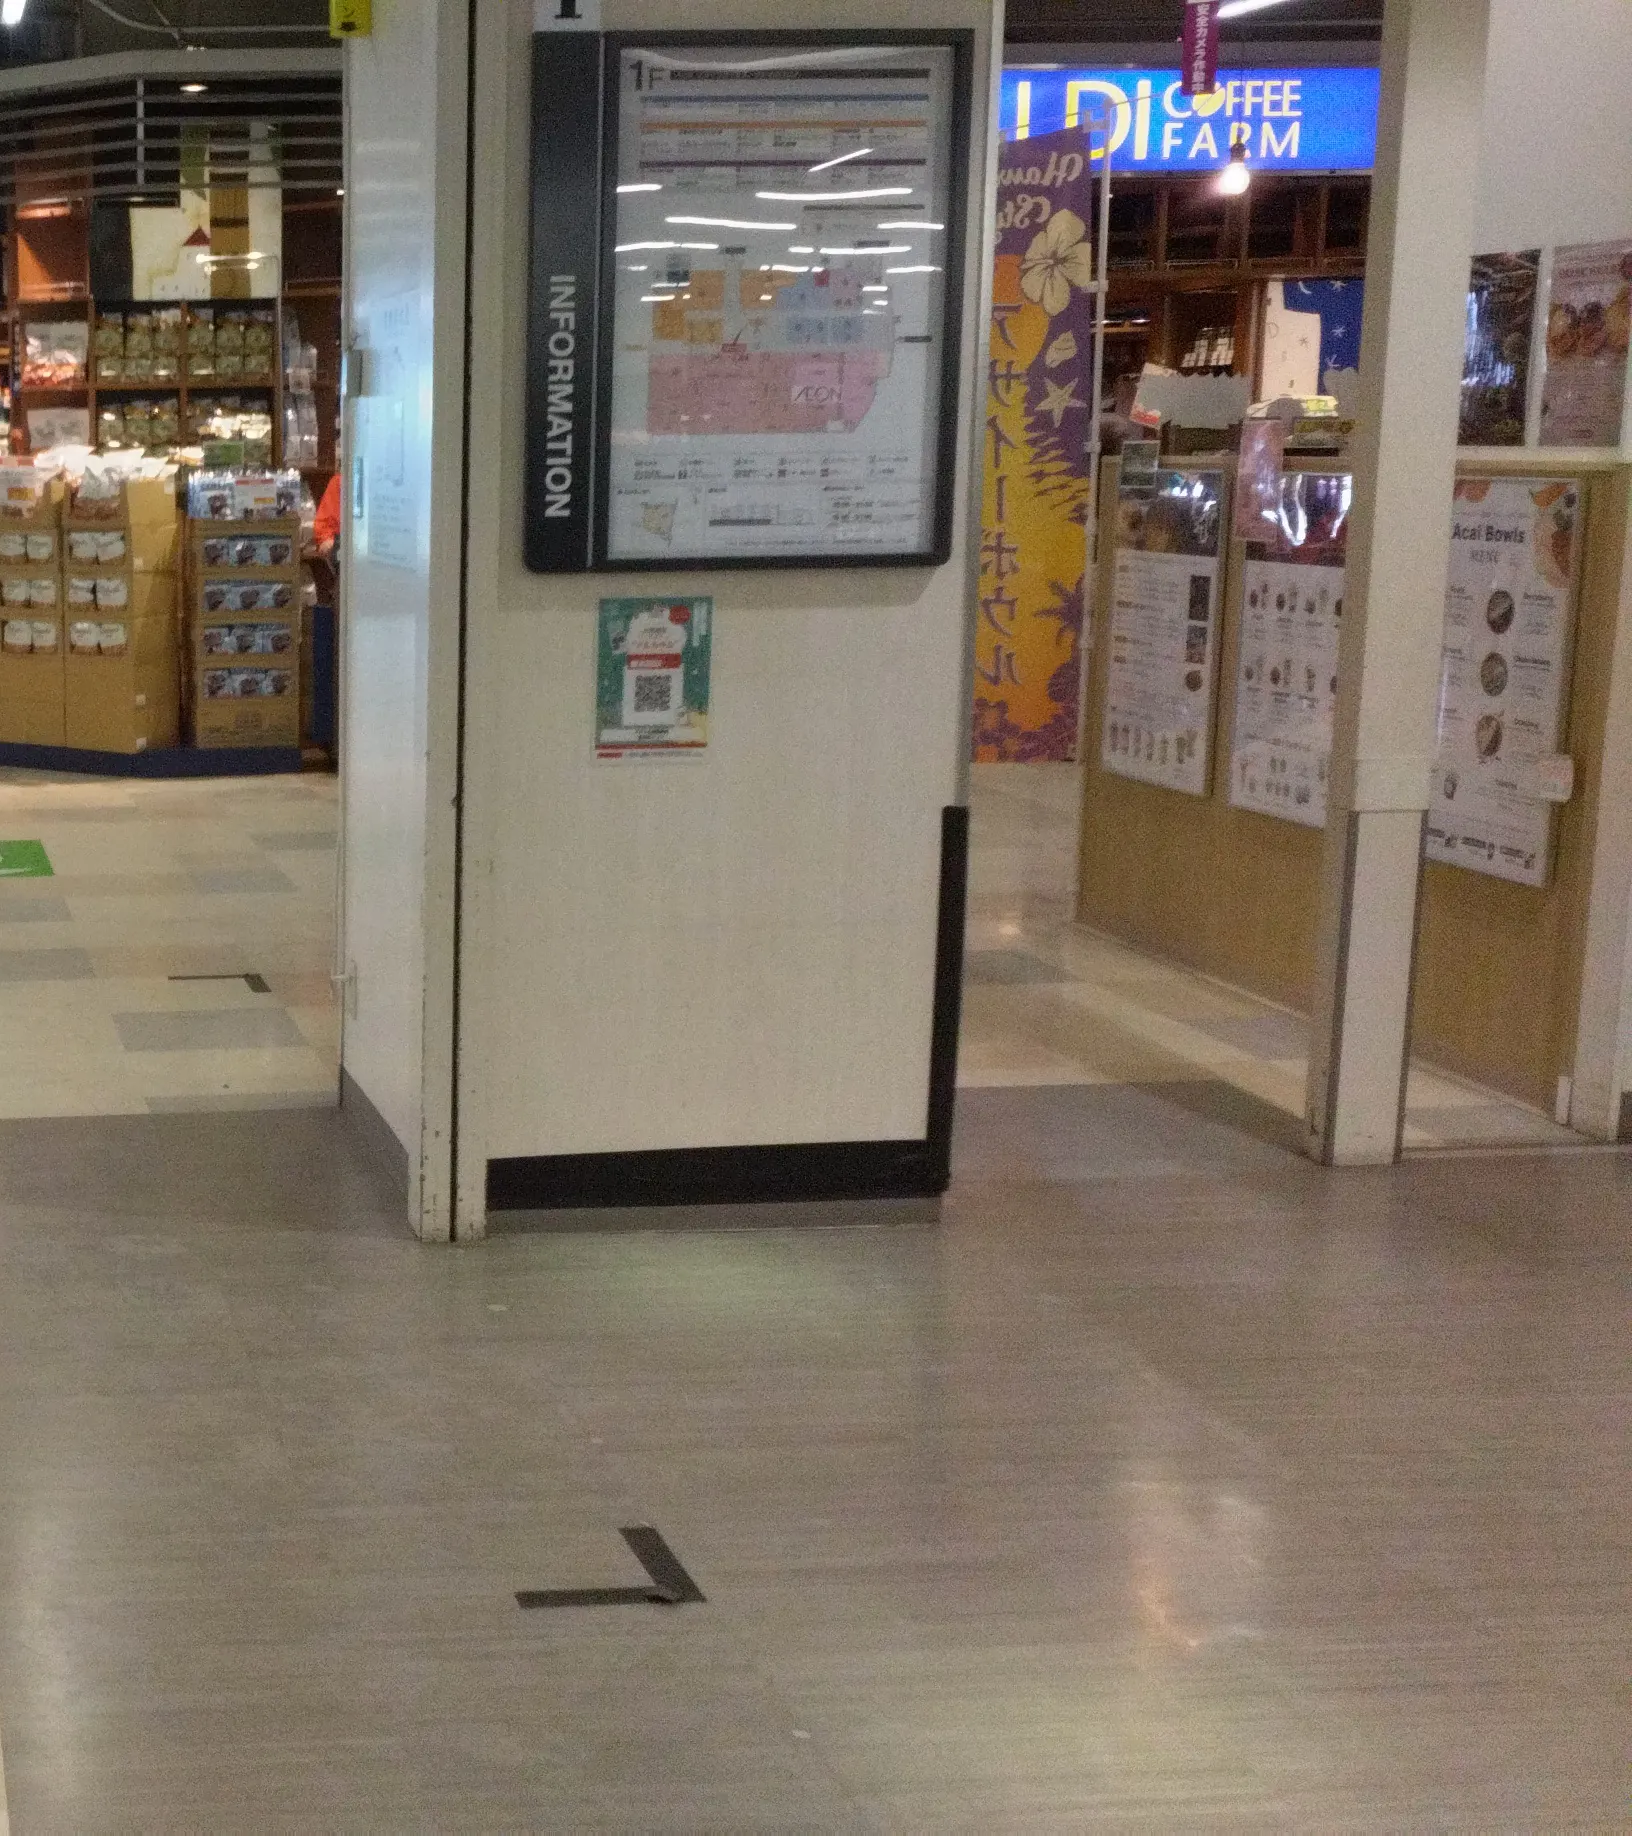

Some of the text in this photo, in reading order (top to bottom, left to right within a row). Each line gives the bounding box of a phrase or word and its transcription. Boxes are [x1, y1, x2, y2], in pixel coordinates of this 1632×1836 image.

[1163, 80, 1303, 118] COFFEE
[1015, 79, 1152, 160] LDI
[1162, 121, 1301, 160] FARM
[544, 275, 576, 518] INFORMATION
[1485, 525, 1525, 544] Bowls
